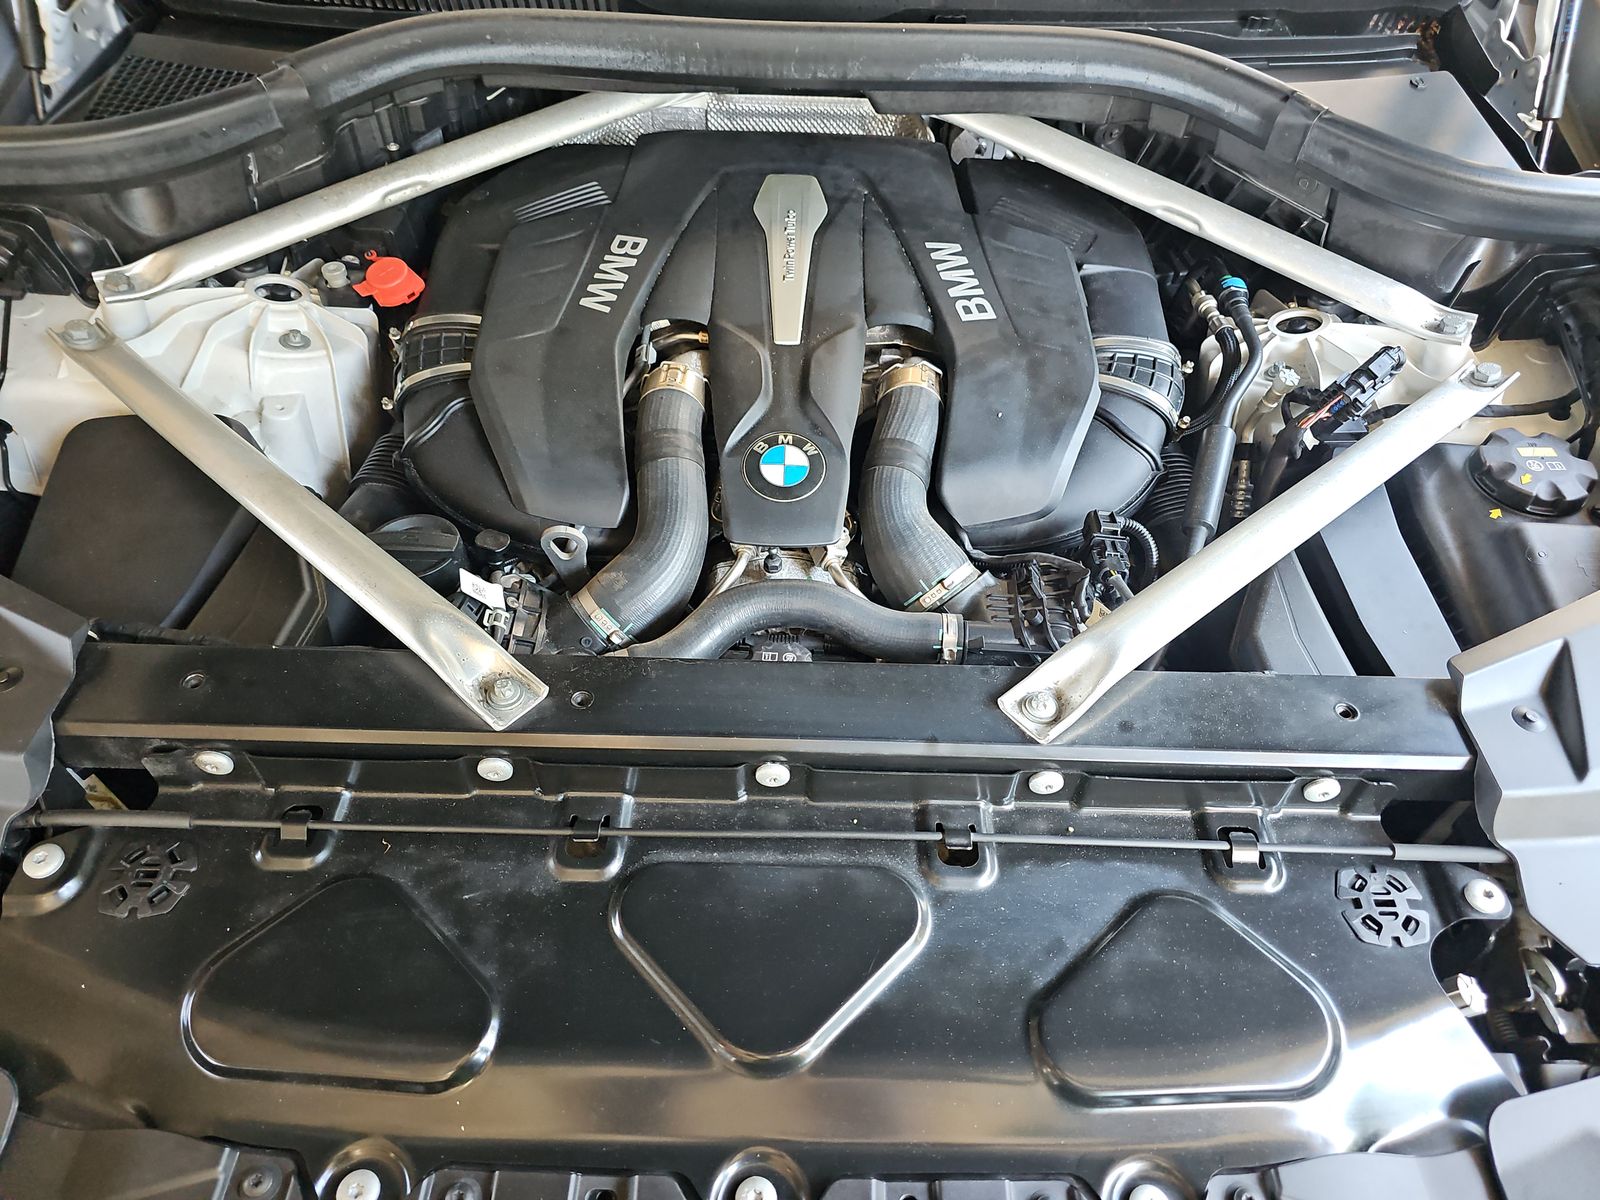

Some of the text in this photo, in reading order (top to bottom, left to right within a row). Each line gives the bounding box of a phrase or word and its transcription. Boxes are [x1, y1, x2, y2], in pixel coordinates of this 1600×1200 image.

[579, 234, 648, 313] BMW
[924, 242, 997, 321] BMW
[753, 434, 819, 456] BMW
